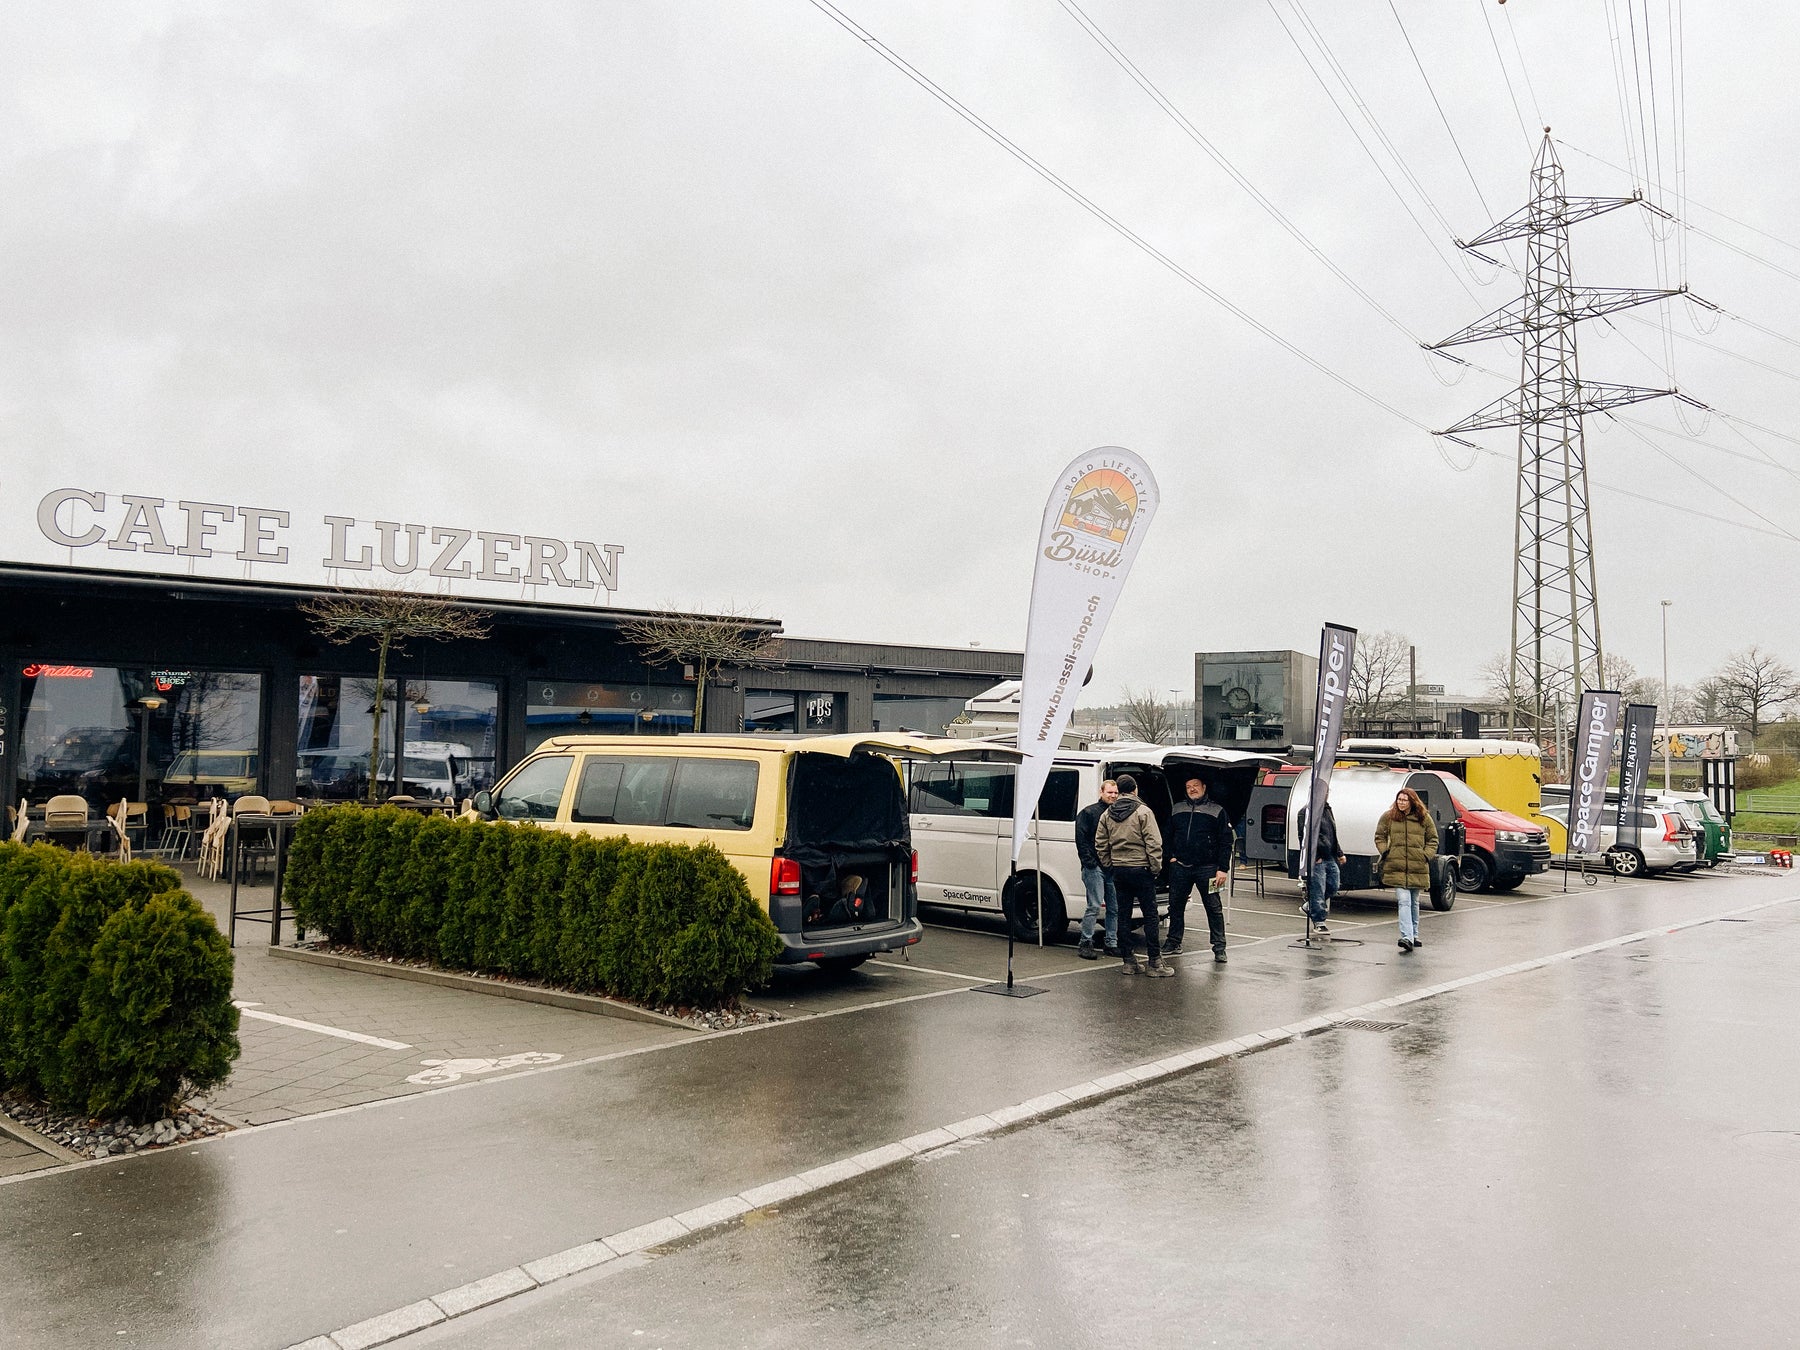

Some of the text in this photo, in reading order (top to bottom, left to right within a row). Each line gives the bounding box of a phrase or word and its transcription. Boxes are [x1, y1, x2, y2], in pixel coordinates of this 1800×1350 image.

[1065, 460, 1147, 514] ROAD LIFESTYLE
[37, 488, 625, 592] CAFE LUZERN
[1044, 531, 1123, 568] Büssli
[1075, 563, 1110, 578] SHOP
[22, 664, 94, 678] Indian
[1037, 595, 1100, 742] www.buessli-shop.ch
[809, 698, 832, 717] FBS
[1572, 696, 1610, 849] SpaceCamper
[1619, 724, 1637, 826] INSEL AUF RÄDERN
[943, 889, 992, 903] SpaceCamper
